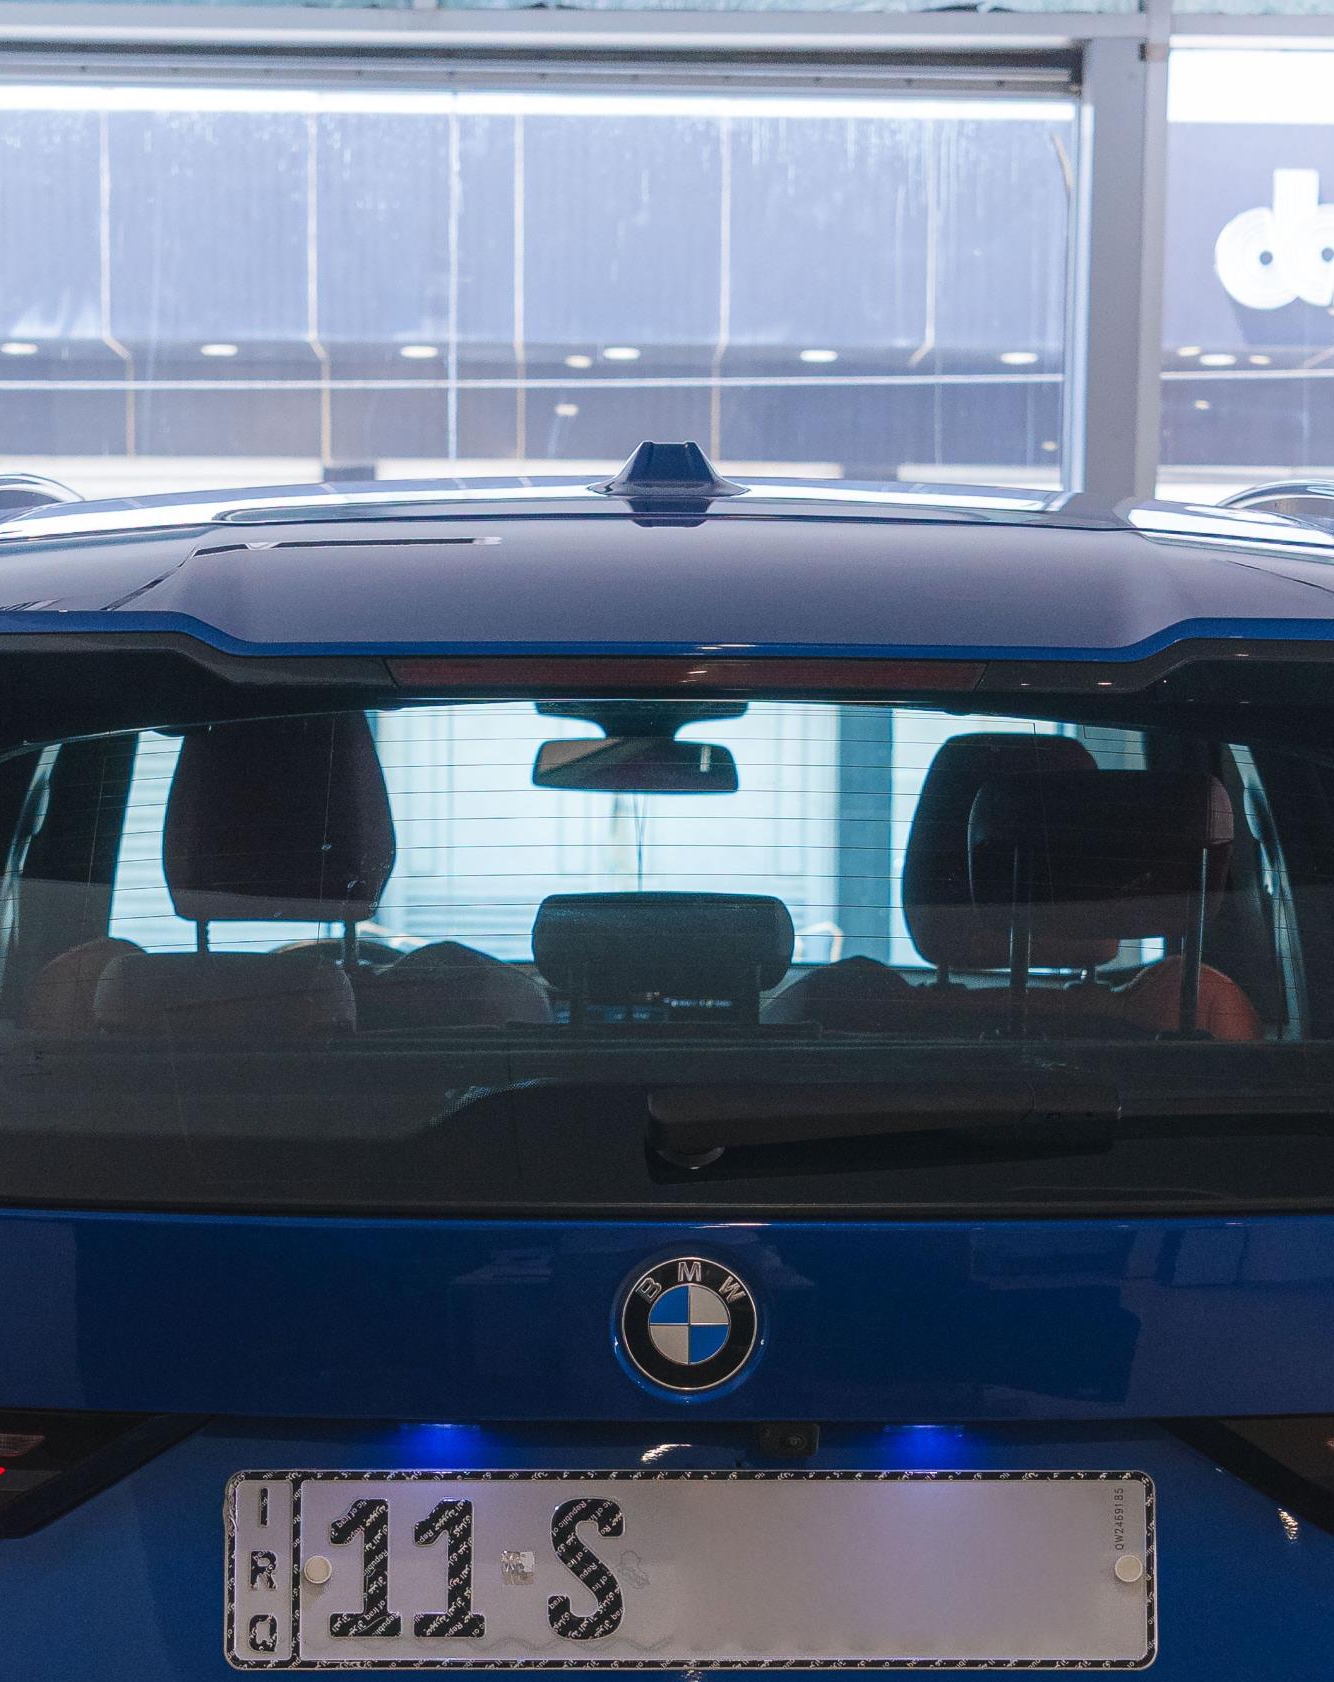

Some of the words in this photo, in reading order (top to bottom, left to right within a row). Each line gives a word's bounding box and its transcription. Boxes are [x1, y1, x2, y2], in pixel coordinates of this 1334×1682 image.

[635, 1261, 746, 1303] BMW
[329, 1497, 486, 1638] 11
[547, 1497, 626, 1641] S
